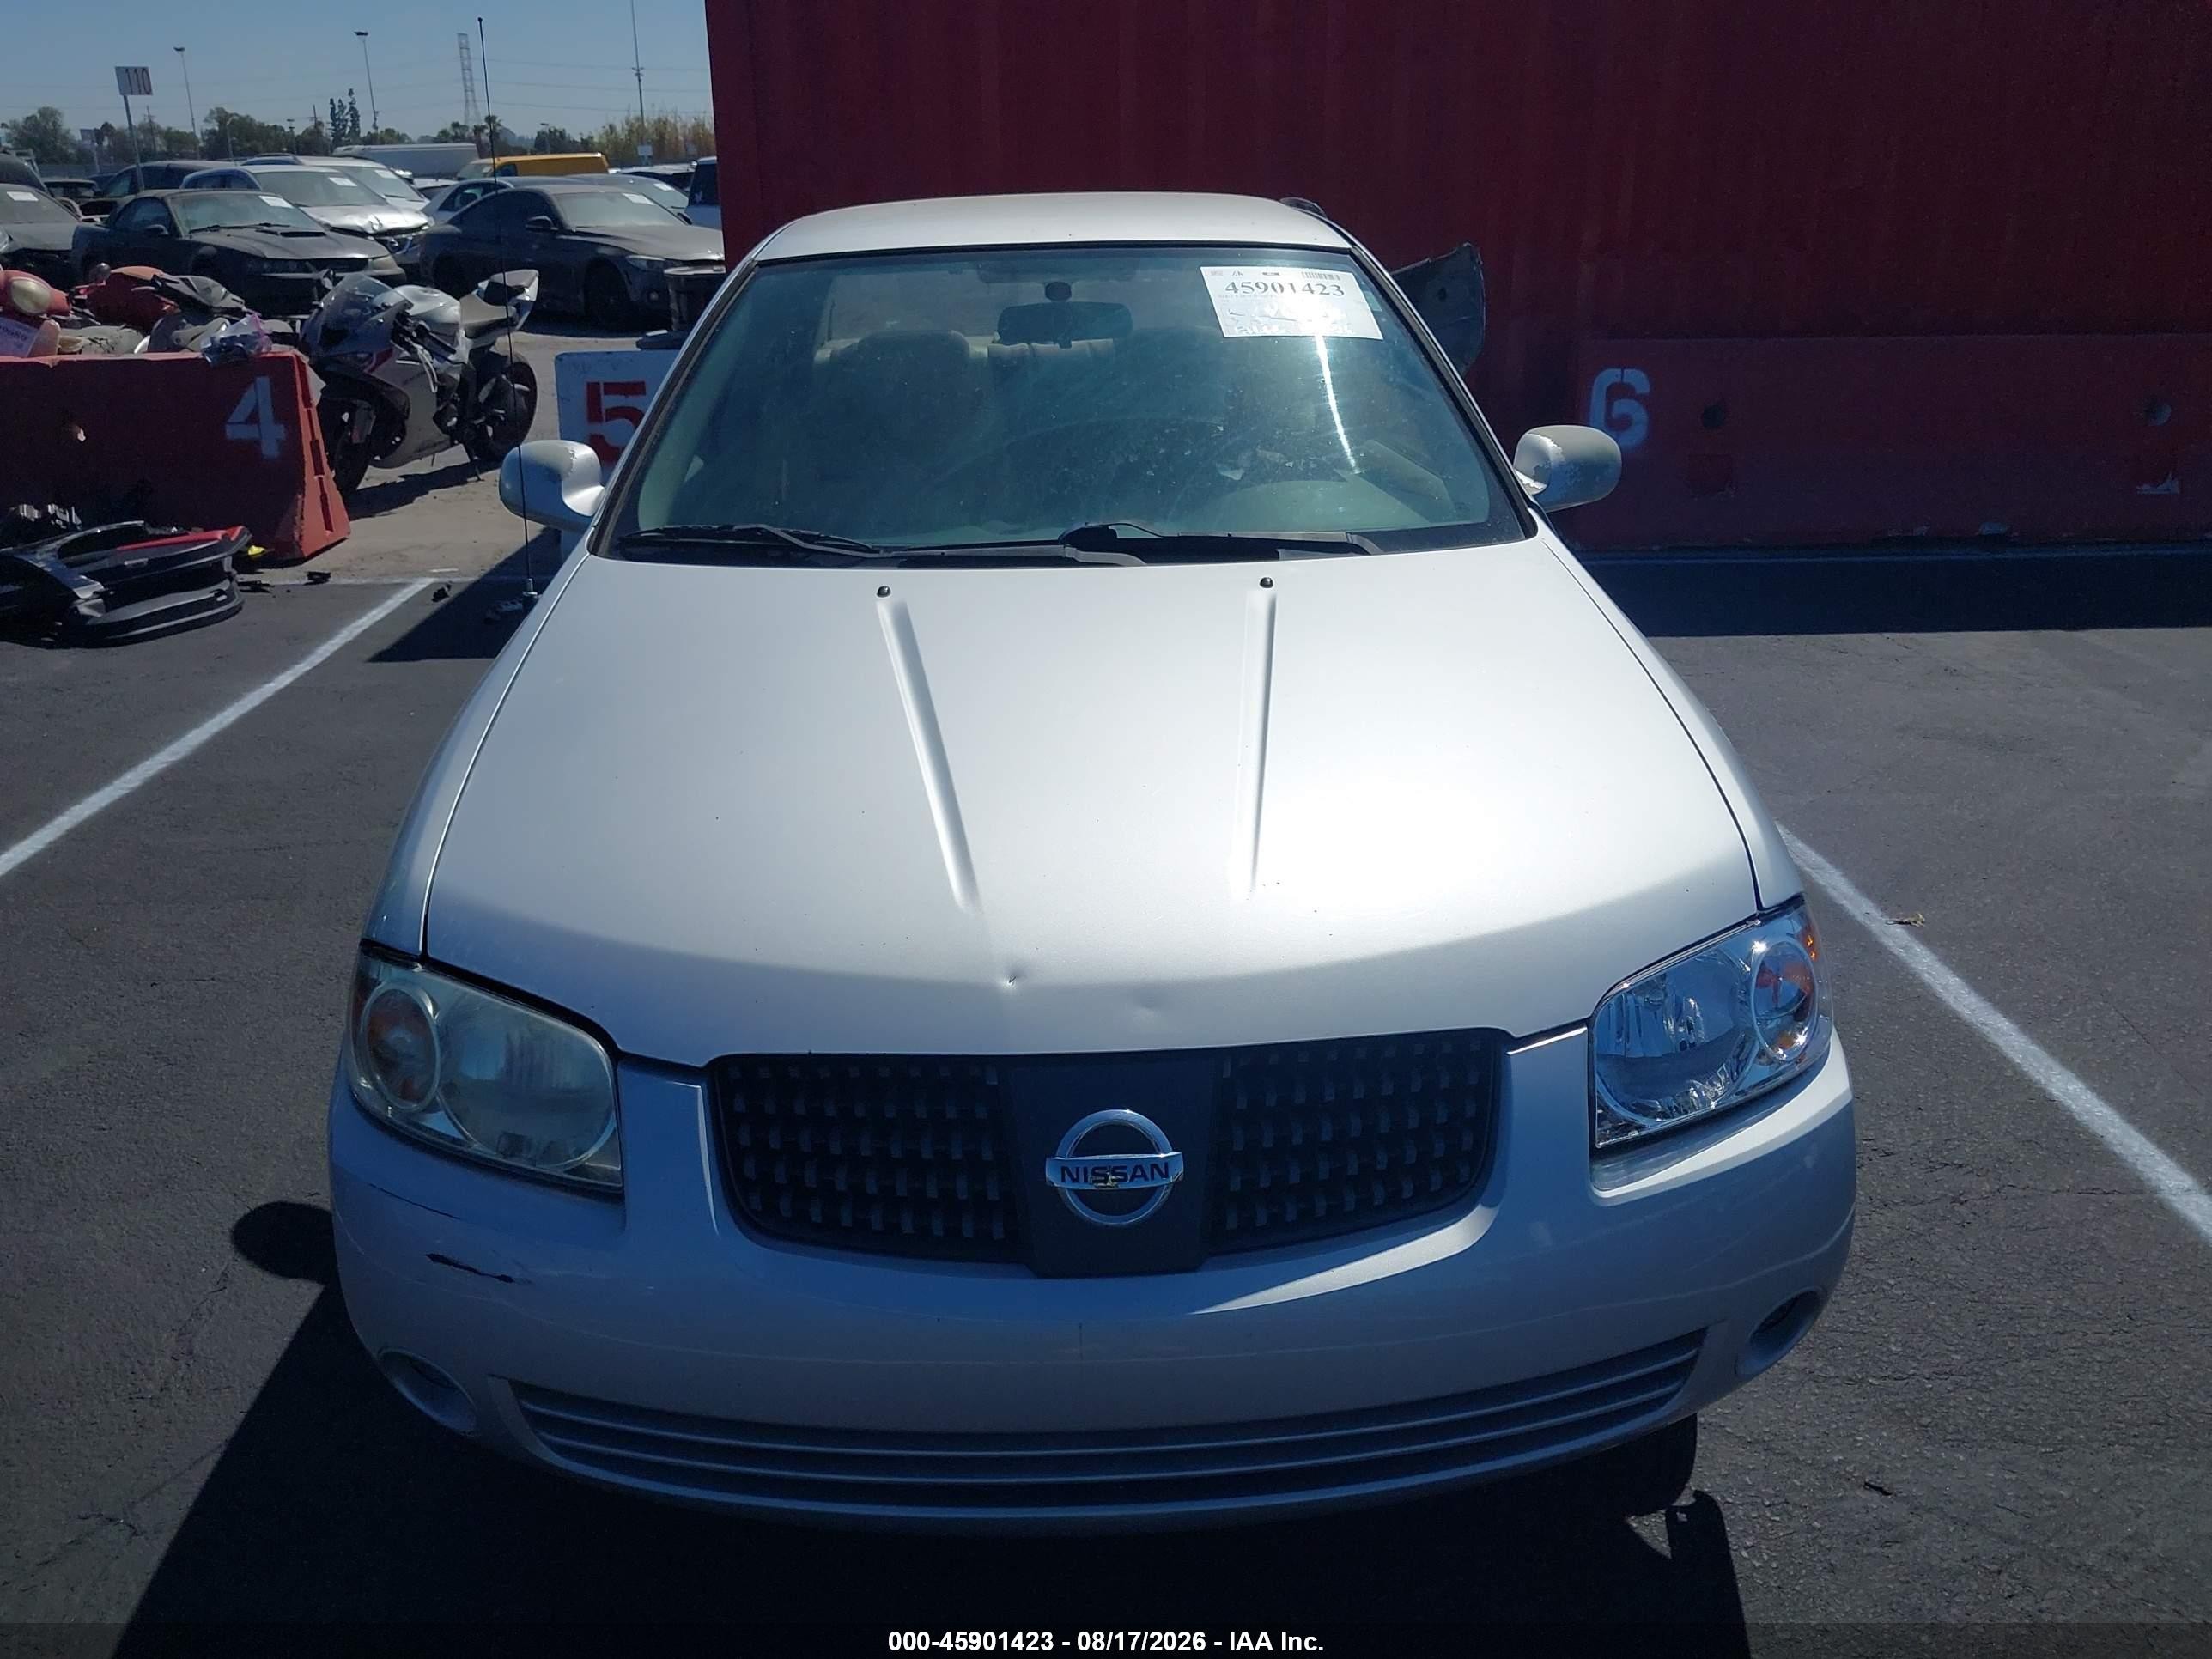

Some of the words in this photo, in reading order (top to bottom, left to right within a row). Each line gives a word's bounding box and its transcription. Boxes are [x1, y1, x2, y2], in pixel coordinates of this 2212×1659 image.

[1224, 281, 1346, 297] 45901423
[225, 376, 286, 459] 4
[586, 380, 647, 467] 5
[1589, 367, 1650, 453] 6
[1060, 1161, 1170, 1184] NISSAN
